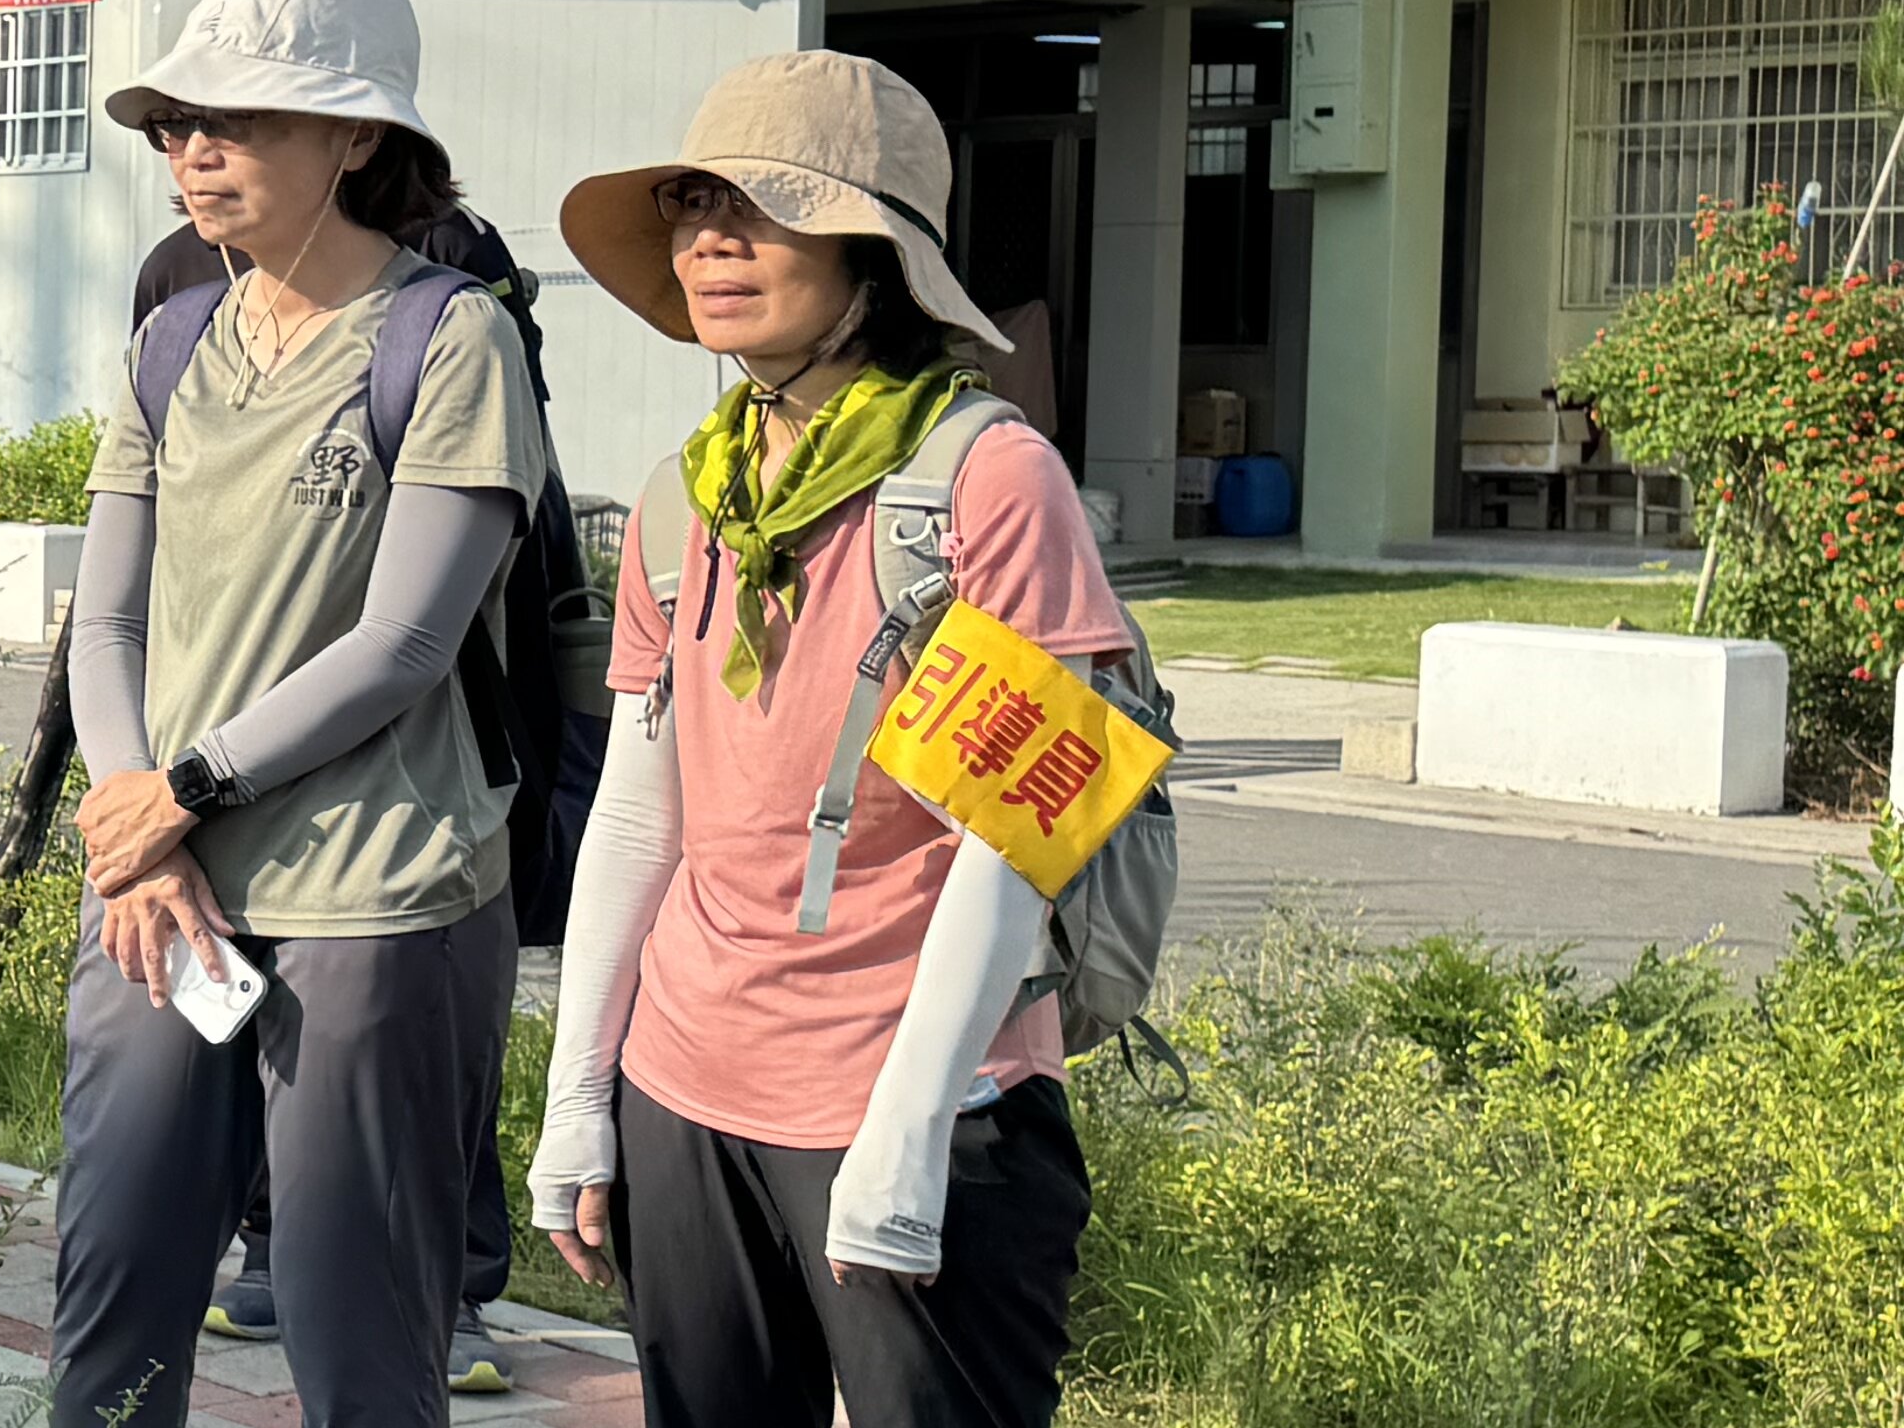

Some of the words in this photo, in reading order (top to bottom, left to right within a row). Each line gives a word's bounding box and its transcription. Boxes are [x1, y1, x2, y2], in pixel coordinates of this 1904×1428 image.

[310, 444, 361, 490] 野
[293, 486, 326, 506] JUST
[896, 642, 1103, 838] 引導員
